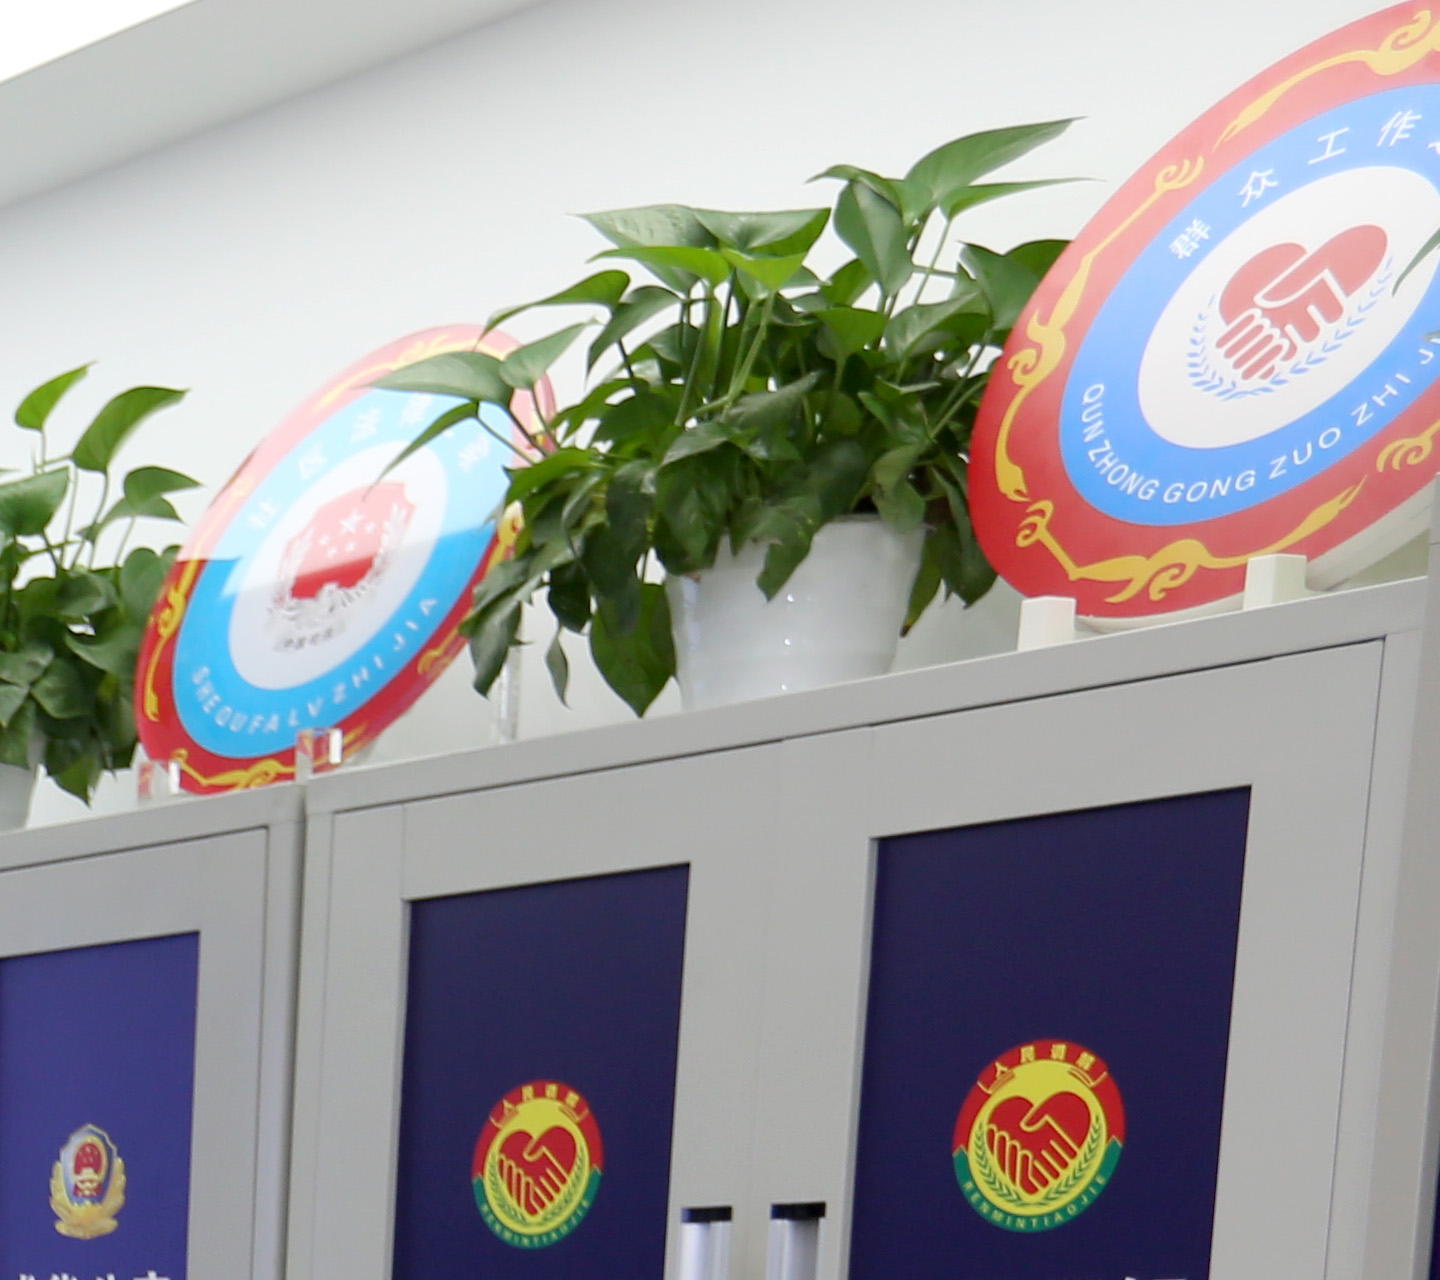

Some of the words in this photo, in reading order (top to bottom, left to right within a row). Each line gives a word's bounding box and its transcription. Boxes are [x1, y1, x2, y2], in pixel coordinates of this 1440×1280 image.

[1169, 107, 1440, 260] 群众工作
[1162, 468, 1255, 504] GONG
[1269, 426, 1342, 480] ZUO
[1352, 372, 1411, 427] ZHI
